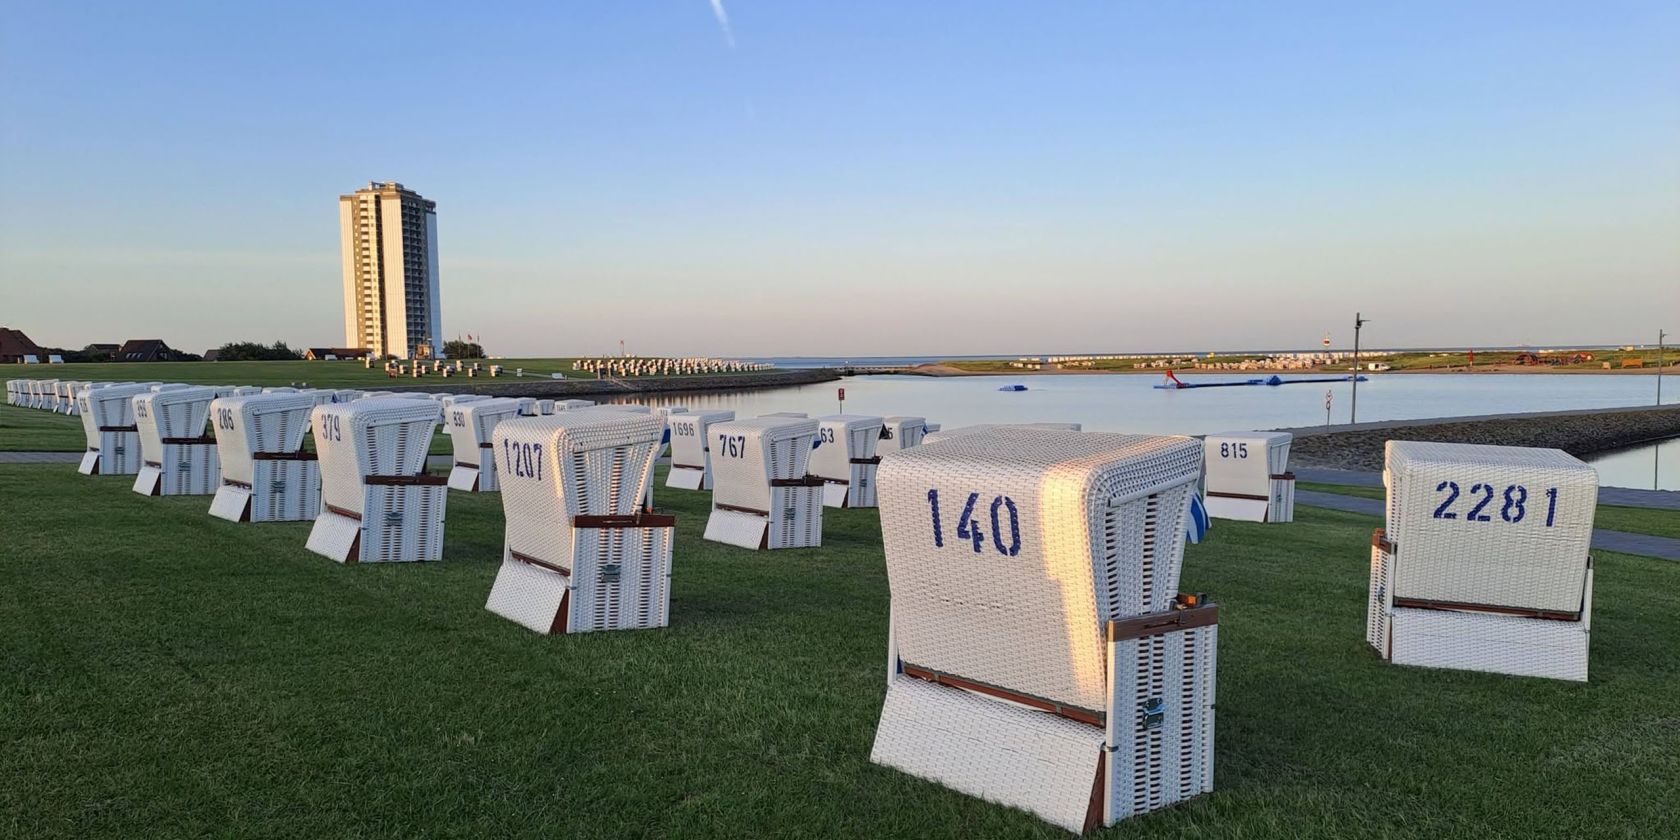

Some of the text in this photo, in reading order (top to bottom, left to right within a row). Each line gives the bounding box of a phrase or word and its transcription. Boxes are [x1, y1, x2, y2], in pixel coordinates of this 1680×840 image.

[217, 407, 235, 431] 286
[320, 414, 342, 442] 379
[672, 421, 695, 437] 1696
[719, 434, 746, 459] 767
[820, 427, 835, 444] 63
[503, 437, 543, 481] 1207
[1220, 442, 1248, 459] 815
[1433, 480, 1559, 528] 2281
[927, 488, 1022, 557] 140
